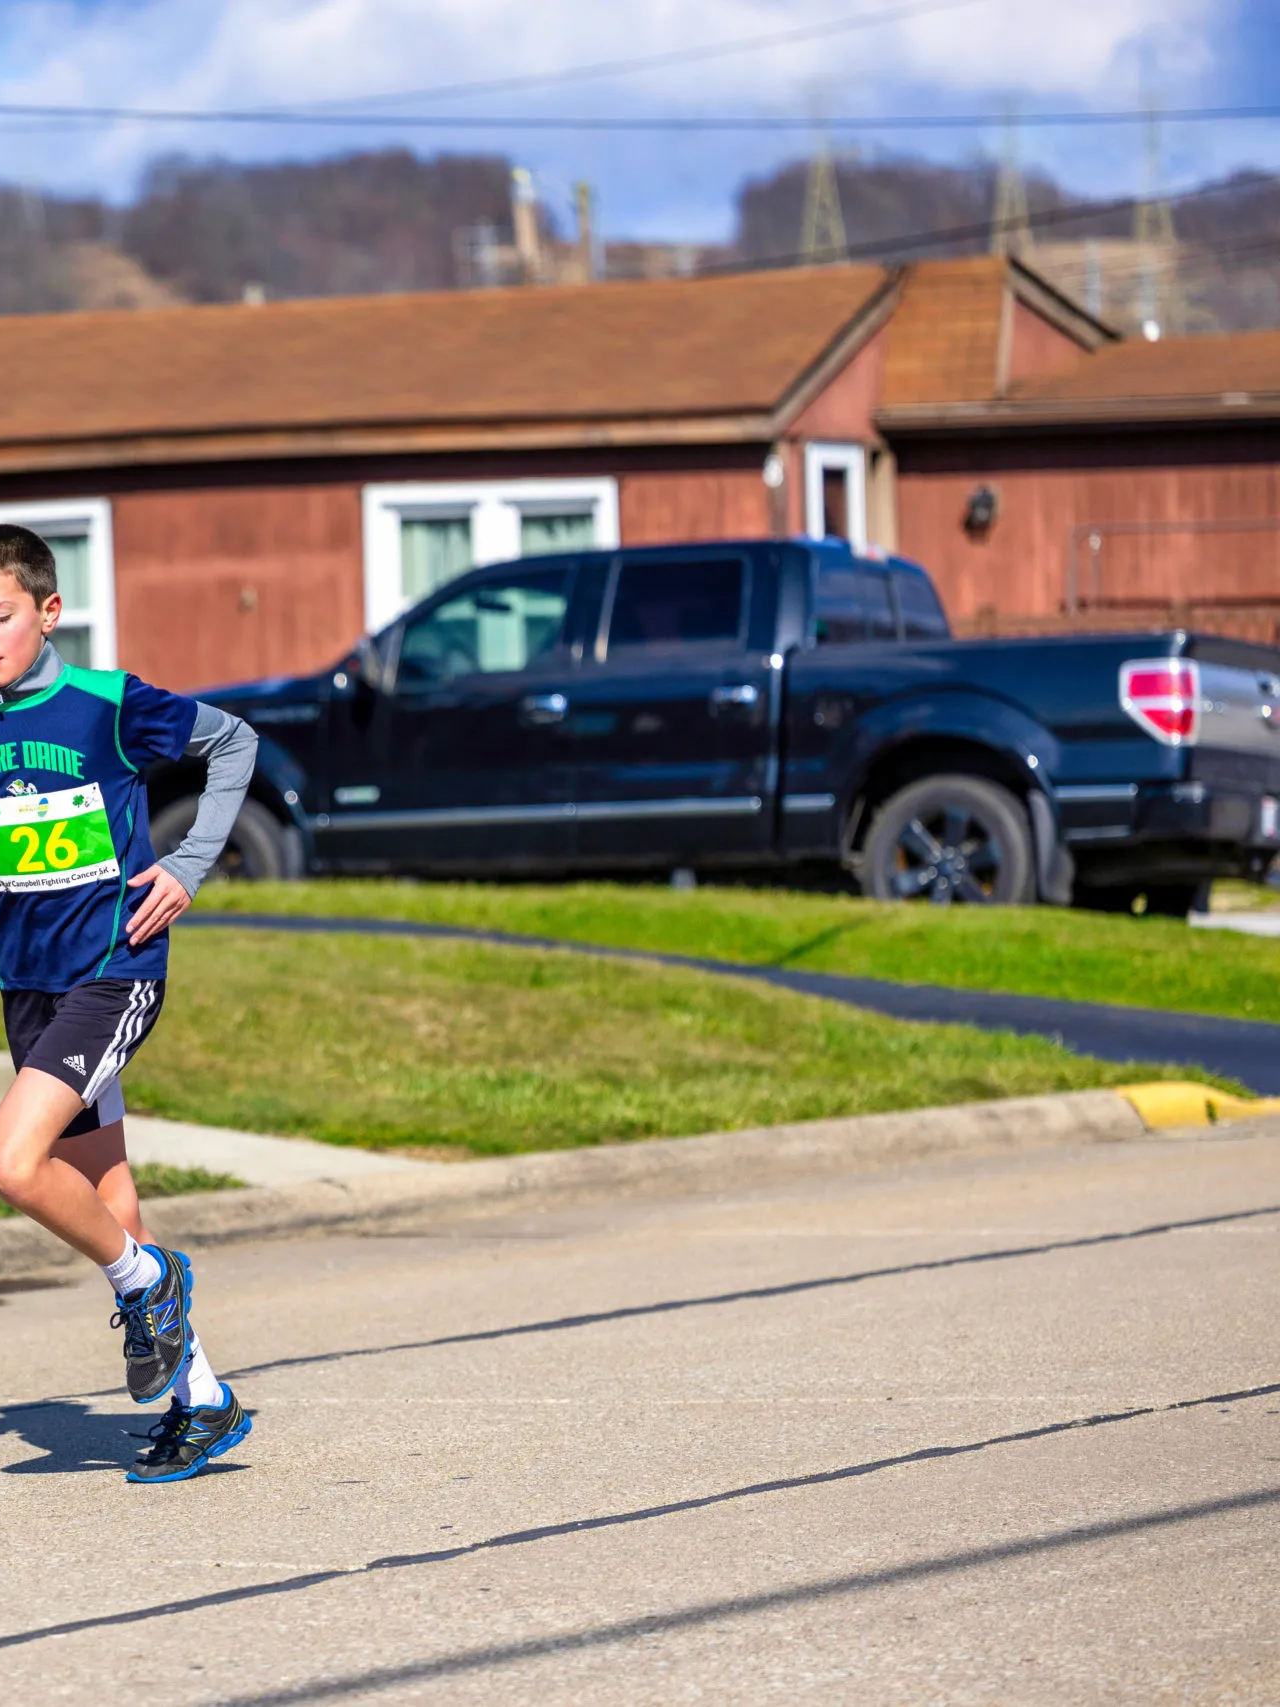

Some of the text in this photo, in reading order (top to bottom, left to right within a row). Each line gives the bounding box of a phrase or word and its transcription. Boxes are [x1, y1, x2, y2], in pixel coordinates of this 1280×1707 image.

[22, 741, 85, 780] DAME
[10, 820, 79, 873] 26
[12, 879, 40, 888] Campbell
[41, 876, 71, 888] Fighting
[71, 870, 98, 881] Cancer
[63, 1058, 87, 1076] adidas
